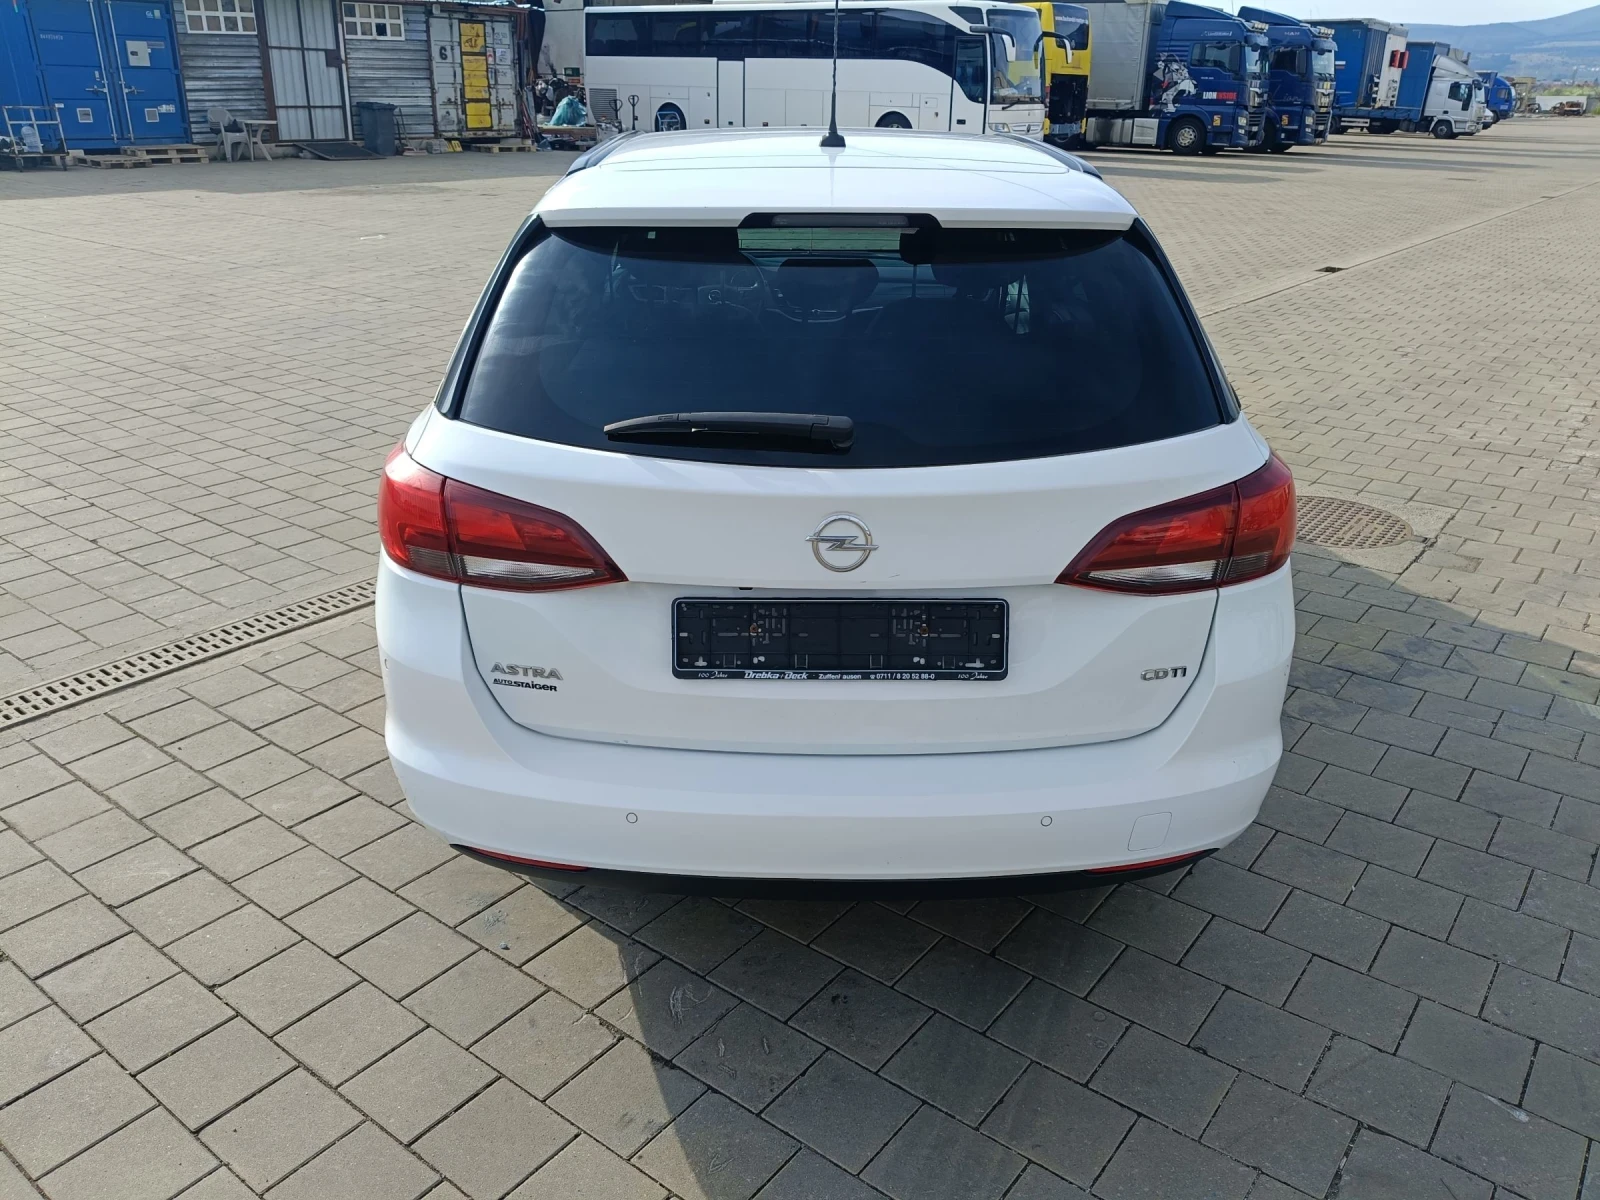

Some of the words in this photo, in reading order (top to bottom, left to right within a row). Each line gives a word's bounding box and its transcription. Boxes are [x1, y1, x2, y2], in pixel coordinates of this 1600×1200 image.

[439, 46, 448, 60] 6
[490, 662, 564, 681] ASTRA
[493, 678, 513, 686] AUTO
